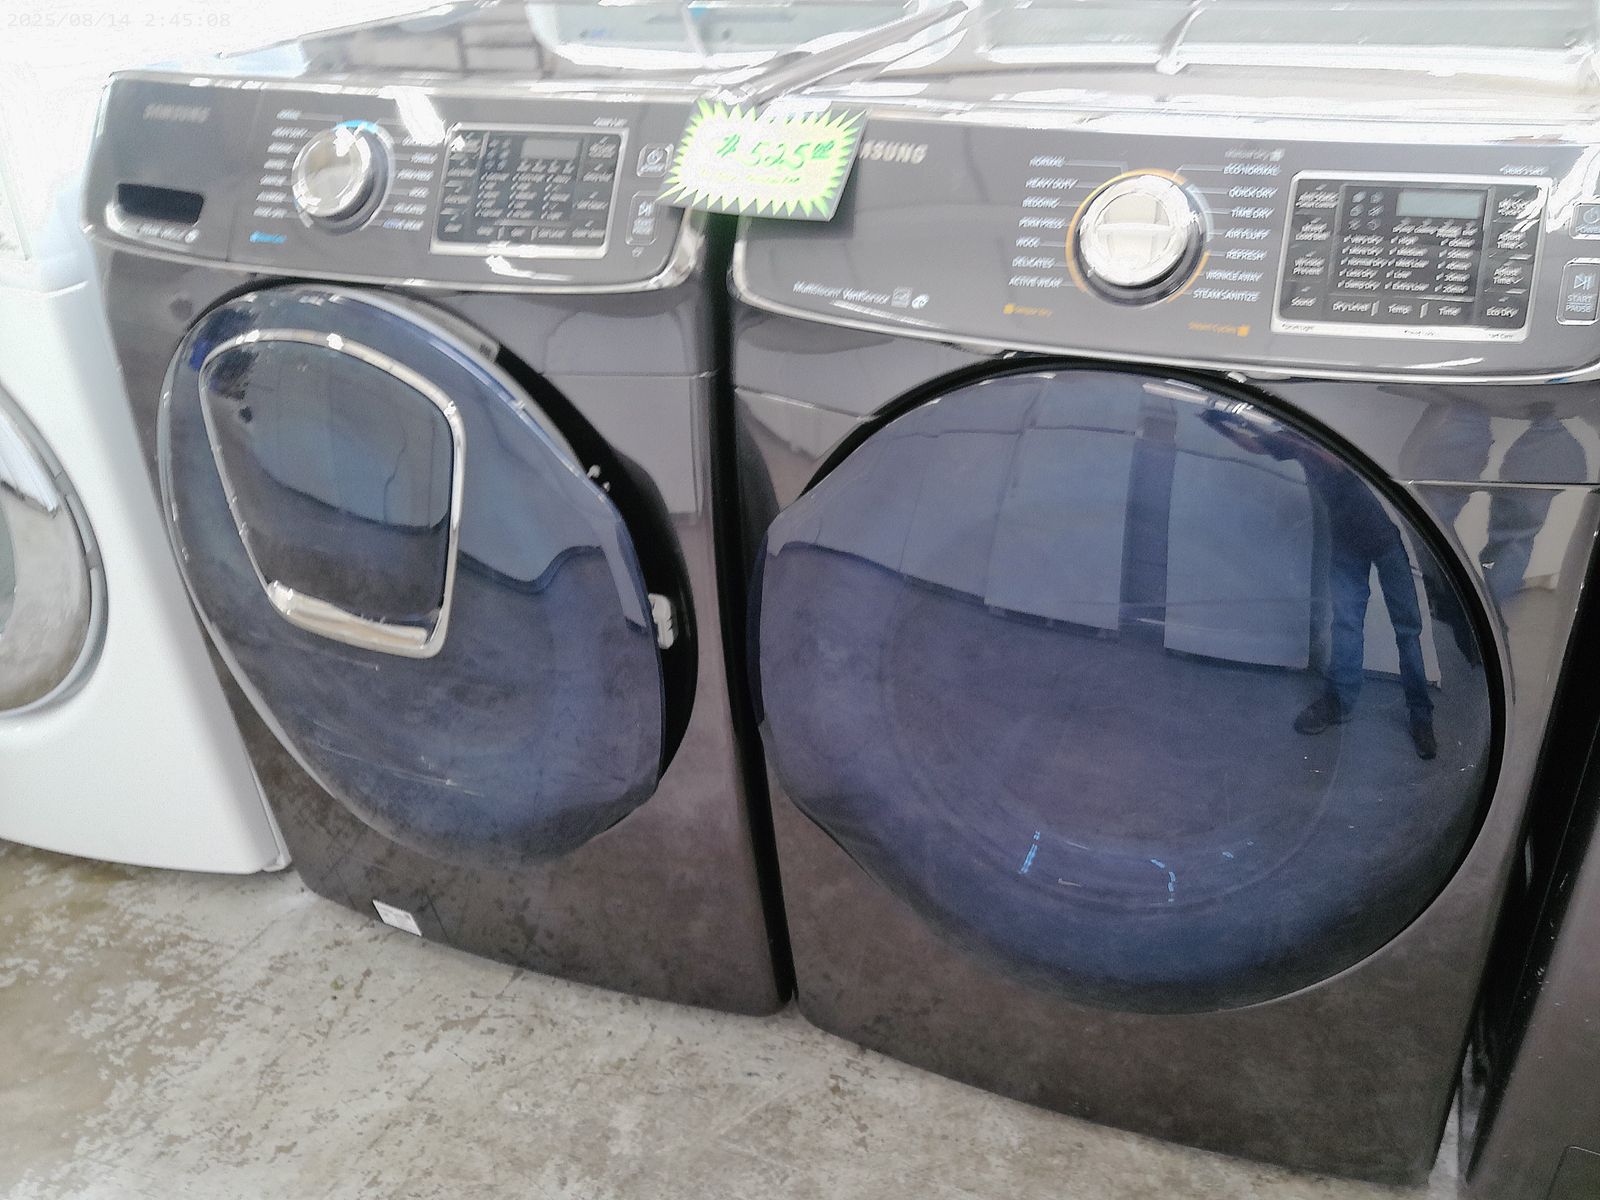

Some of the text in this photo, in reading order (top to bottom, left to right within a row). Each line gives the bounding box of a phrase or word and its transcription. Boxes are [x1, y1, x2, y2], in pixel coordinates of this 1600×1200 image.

[1256, 187, 1278, 198] DRY
[1231, 207, 1275, 219] TIME DRY
[1224, 228, 1242, 239] AIR
[1226, 248, 1267, 260] REFRESH
[1008, 276, 1063, 288] ACTIVE WEAR
[1192, 288, 1260, 302] STEAM SANITIZE
[1567, 293, 1593, 303] START
[1388, 304, 1412, 315] Temp
[1439, 305, 1461, 316] Time
